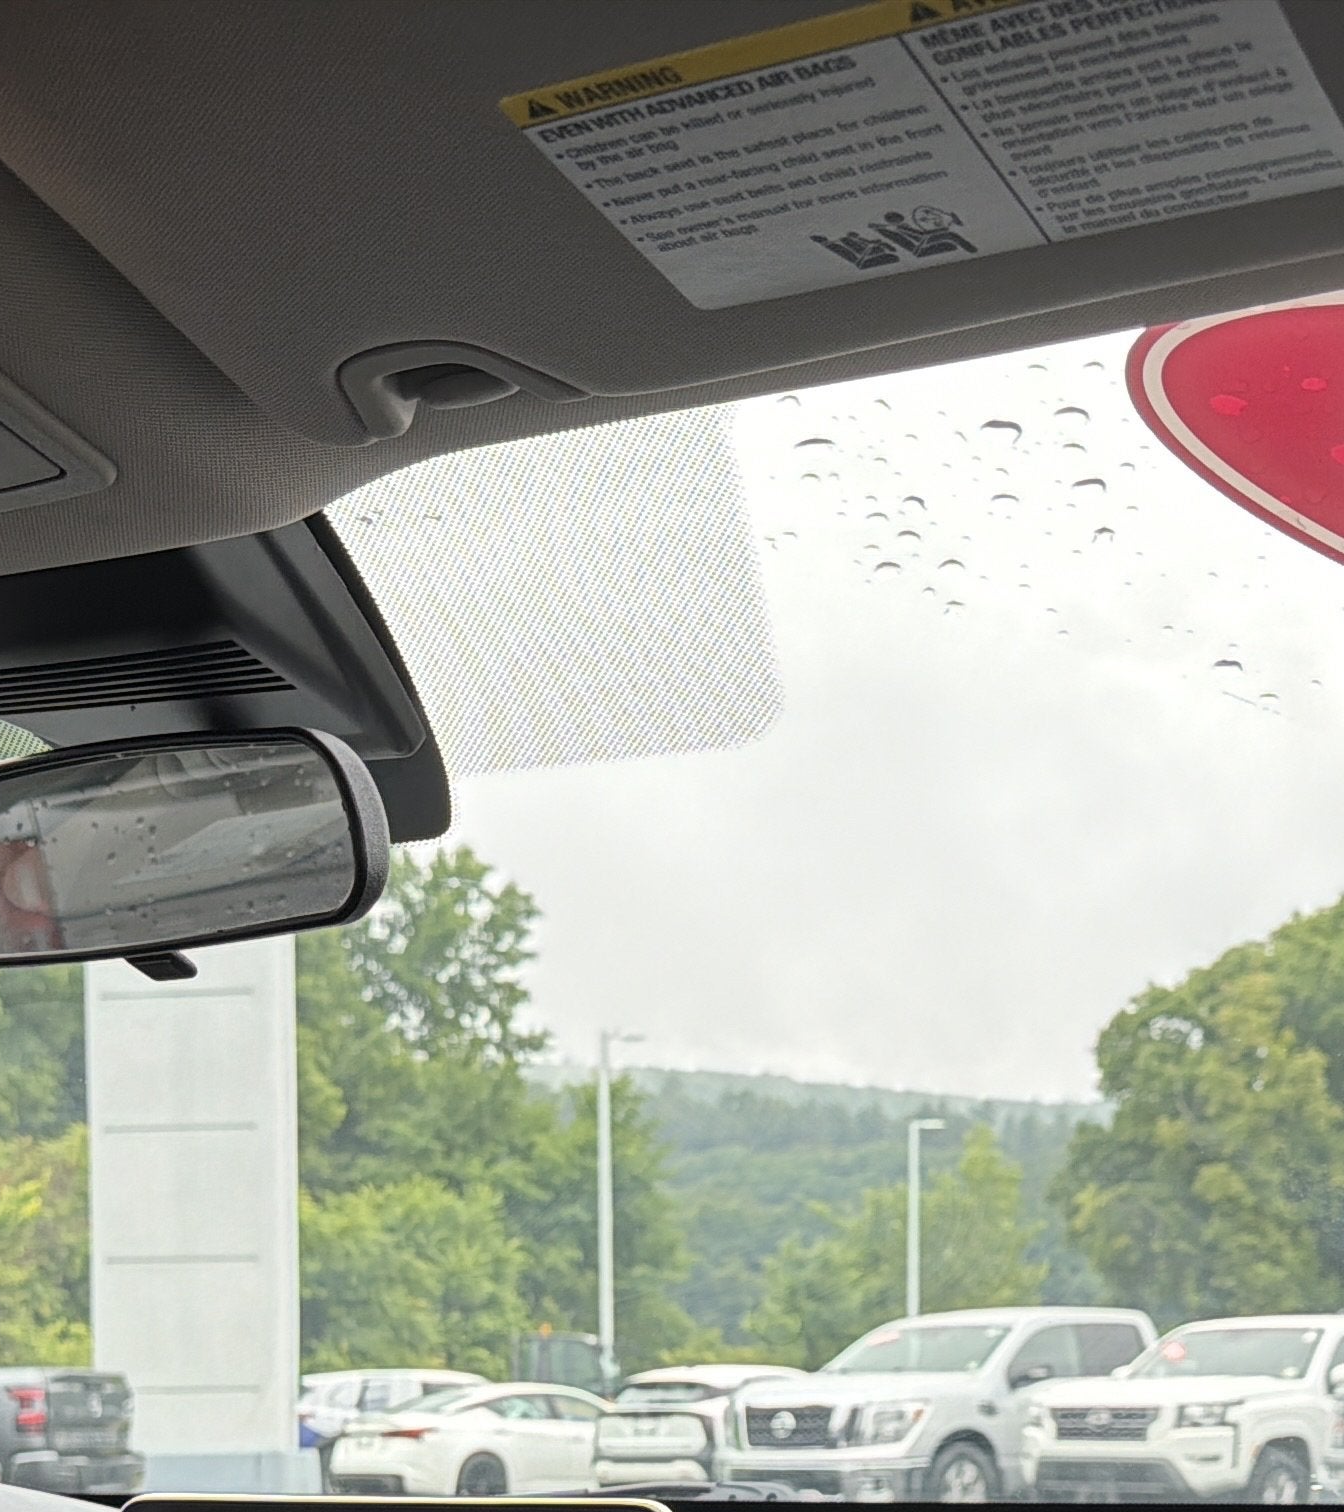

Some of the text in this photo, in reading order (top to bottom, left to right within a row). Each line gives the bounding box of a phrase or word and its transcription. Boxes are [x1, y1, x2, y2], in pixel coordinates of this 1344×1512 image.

[537, 54, 856, 143] EVEN WITH ADVANCED AIR BAGS
[557, 66, 683, 110] WARNING
[566, 136, 628, 159] Children
[629, 130, 657, 144] can
[681, 112, 724, 131] killed
[576, 139, 680, 173] by the air bag
[592, 174, 623, 190] The
[625, 166, 660, 182] back
[657, 183, 685, 198] put
[782, 151, 820, 169] child
